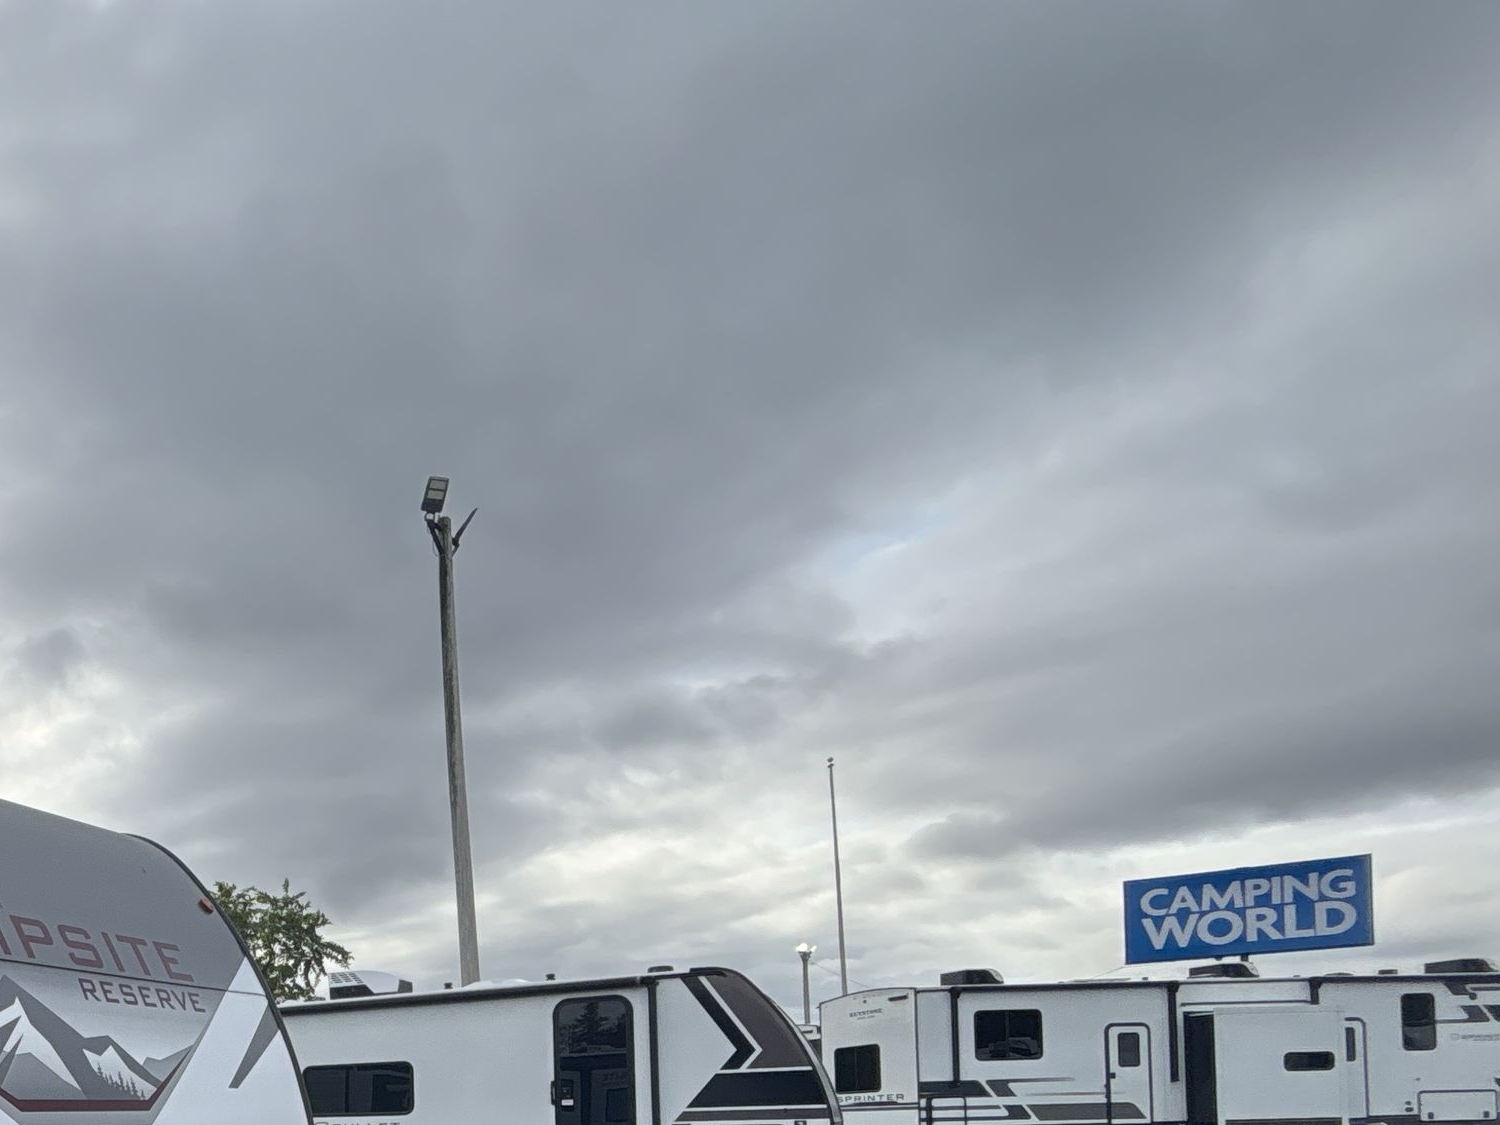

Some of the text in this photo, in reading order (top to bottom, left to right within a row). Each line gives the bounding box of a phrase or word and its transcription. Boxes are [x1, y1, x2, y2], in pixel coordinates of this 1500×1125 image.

[1140, 869, 1357, 916] CAMPING
[1141, 900, 1358, 951] WORLD
[78, 977, 207, 1014] RESERVE
